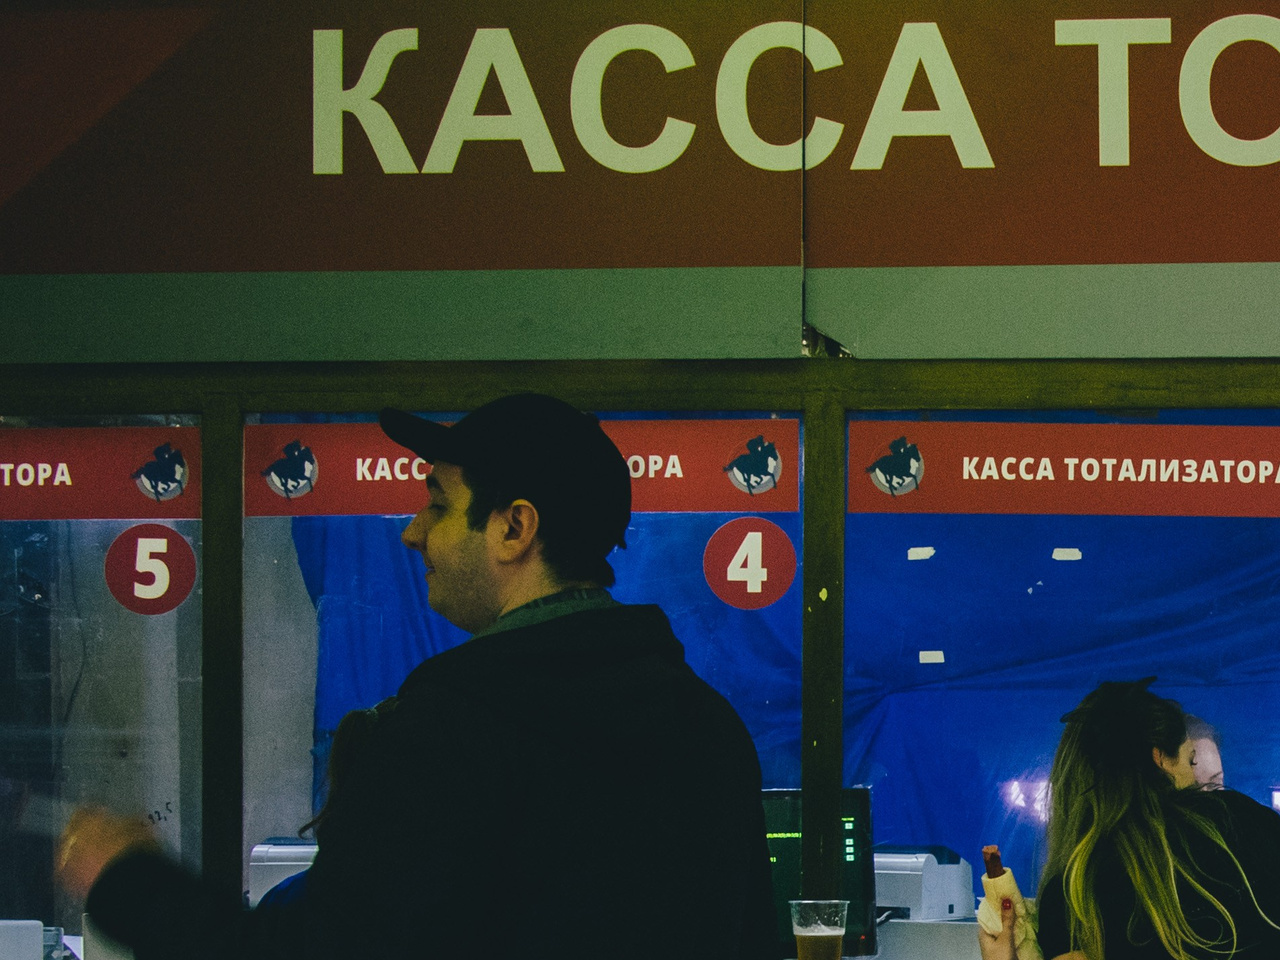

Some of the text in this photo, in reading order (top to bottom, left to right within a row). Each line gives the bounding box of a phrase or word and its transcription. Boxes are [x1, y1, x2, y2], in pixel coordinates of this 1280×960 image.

[312, 21, 995, 175] КАССА
[962, 456, 1055, 481] КАССА
[133, 537, 170, 600] 5
[726, 531, 768, 593] 4
